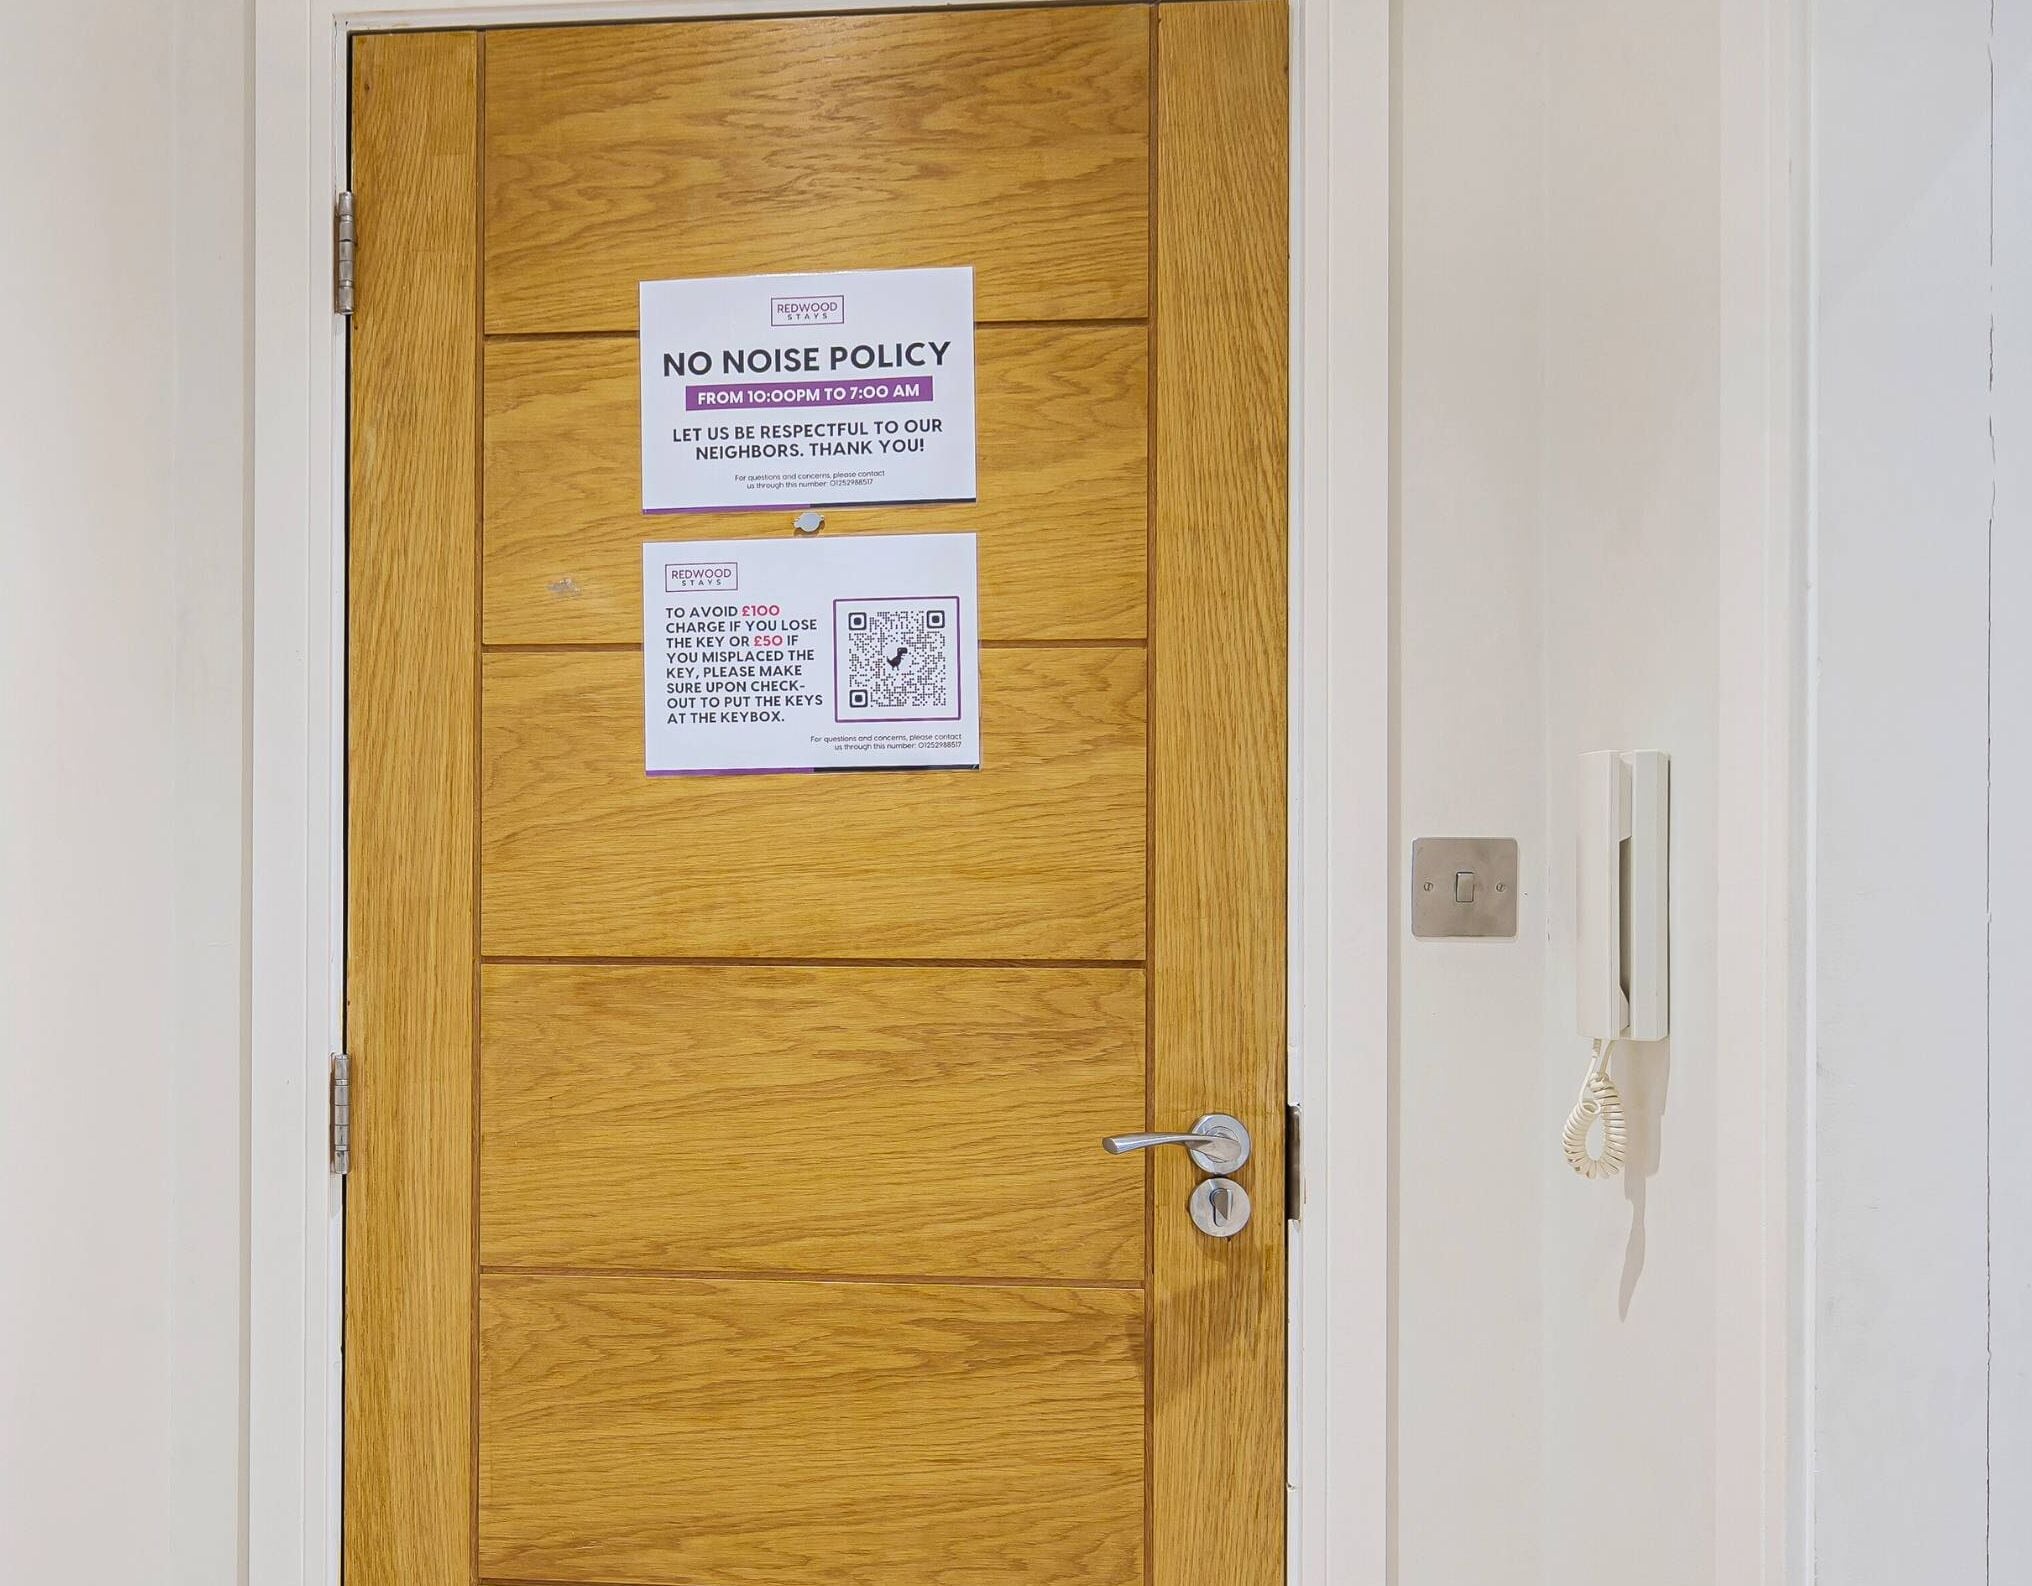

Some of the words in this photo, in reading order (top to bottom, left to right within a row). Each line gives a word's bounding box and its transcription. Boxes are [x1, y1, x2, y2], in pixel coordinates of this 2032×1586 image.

[777, 302, 837, 314] REDWOOD
[664, 351, 712, 376] NO
[723, 347, 820, 374] NOISE
[831, 341, 951, 370] POLICY
[698, 391, 743, 404] FROM
[748, 388, 819, 403] 10:00PM
[824, 387, 845, 400] TO
[850, 386, 888, 400] 7:00
[893, 384, 919, 397] AM
[673, 428, 701, 442] LET
[707, 427, 729, 440] US
[735, 426, 755, 439] BE
[761, 422, 868, 438] RESPECTFUL
[874, 421, 898, 434] TO
[904, 418, 943, 433] OUR
[696, 443, 804, 460] NEIGHBORS.
[809, 441, 872, 456] THANK
[879, 438, 924, 453] YOU!
[748, 474, 780, 482] questions
[756, 482, 784, 490] through
[672, 568, 732, 580] REDWOOD
[682, 578, 721, 586] STAYS
[666, 607, 685, 619] TO
[689, 606, 738, 618] AVOID
[742, 605, 779, 617] £100
[666, 621, 725, 633] CHARGE
[730, 621, 742, 632] IF
[746, 620, 778, 632] YOU
[781, 619, 817, 631] LOSE
[667, 637, 692, 649] THE
[696, 636, 724, 648] KEY
[730, 636, 750, 647] OR
[754, 635, 783, 647] £50
[787, 634, 798, 646] IF
[667, 652, 698, 664] YOU
[702, 650, 784, 663] MISPLACED
[788, 650, 814, 661] THE
[667, 667, 699, 680] KEY,
[704, 666, 755, 678] PLEASE
[759, 665, 801, 677] MAKE
[667, 682, 702, 694] SURE
[706, 681, 746, 693] UPON
[751, 680, 805, 692] CHECK-
[667, 697, 696, 709] OUT
[700, 697, 719, 708] TO
[724, 696, 750, 708] PUT
[755, 695, 781, 707] THE
[785, 694, 823, 706] KEYS
[667, 713, 687, 724] AT
[690, 712, 716, 723] THE
[721, 711, 784, 723] KEYBOX.
[844, 743, 872, 751] through
